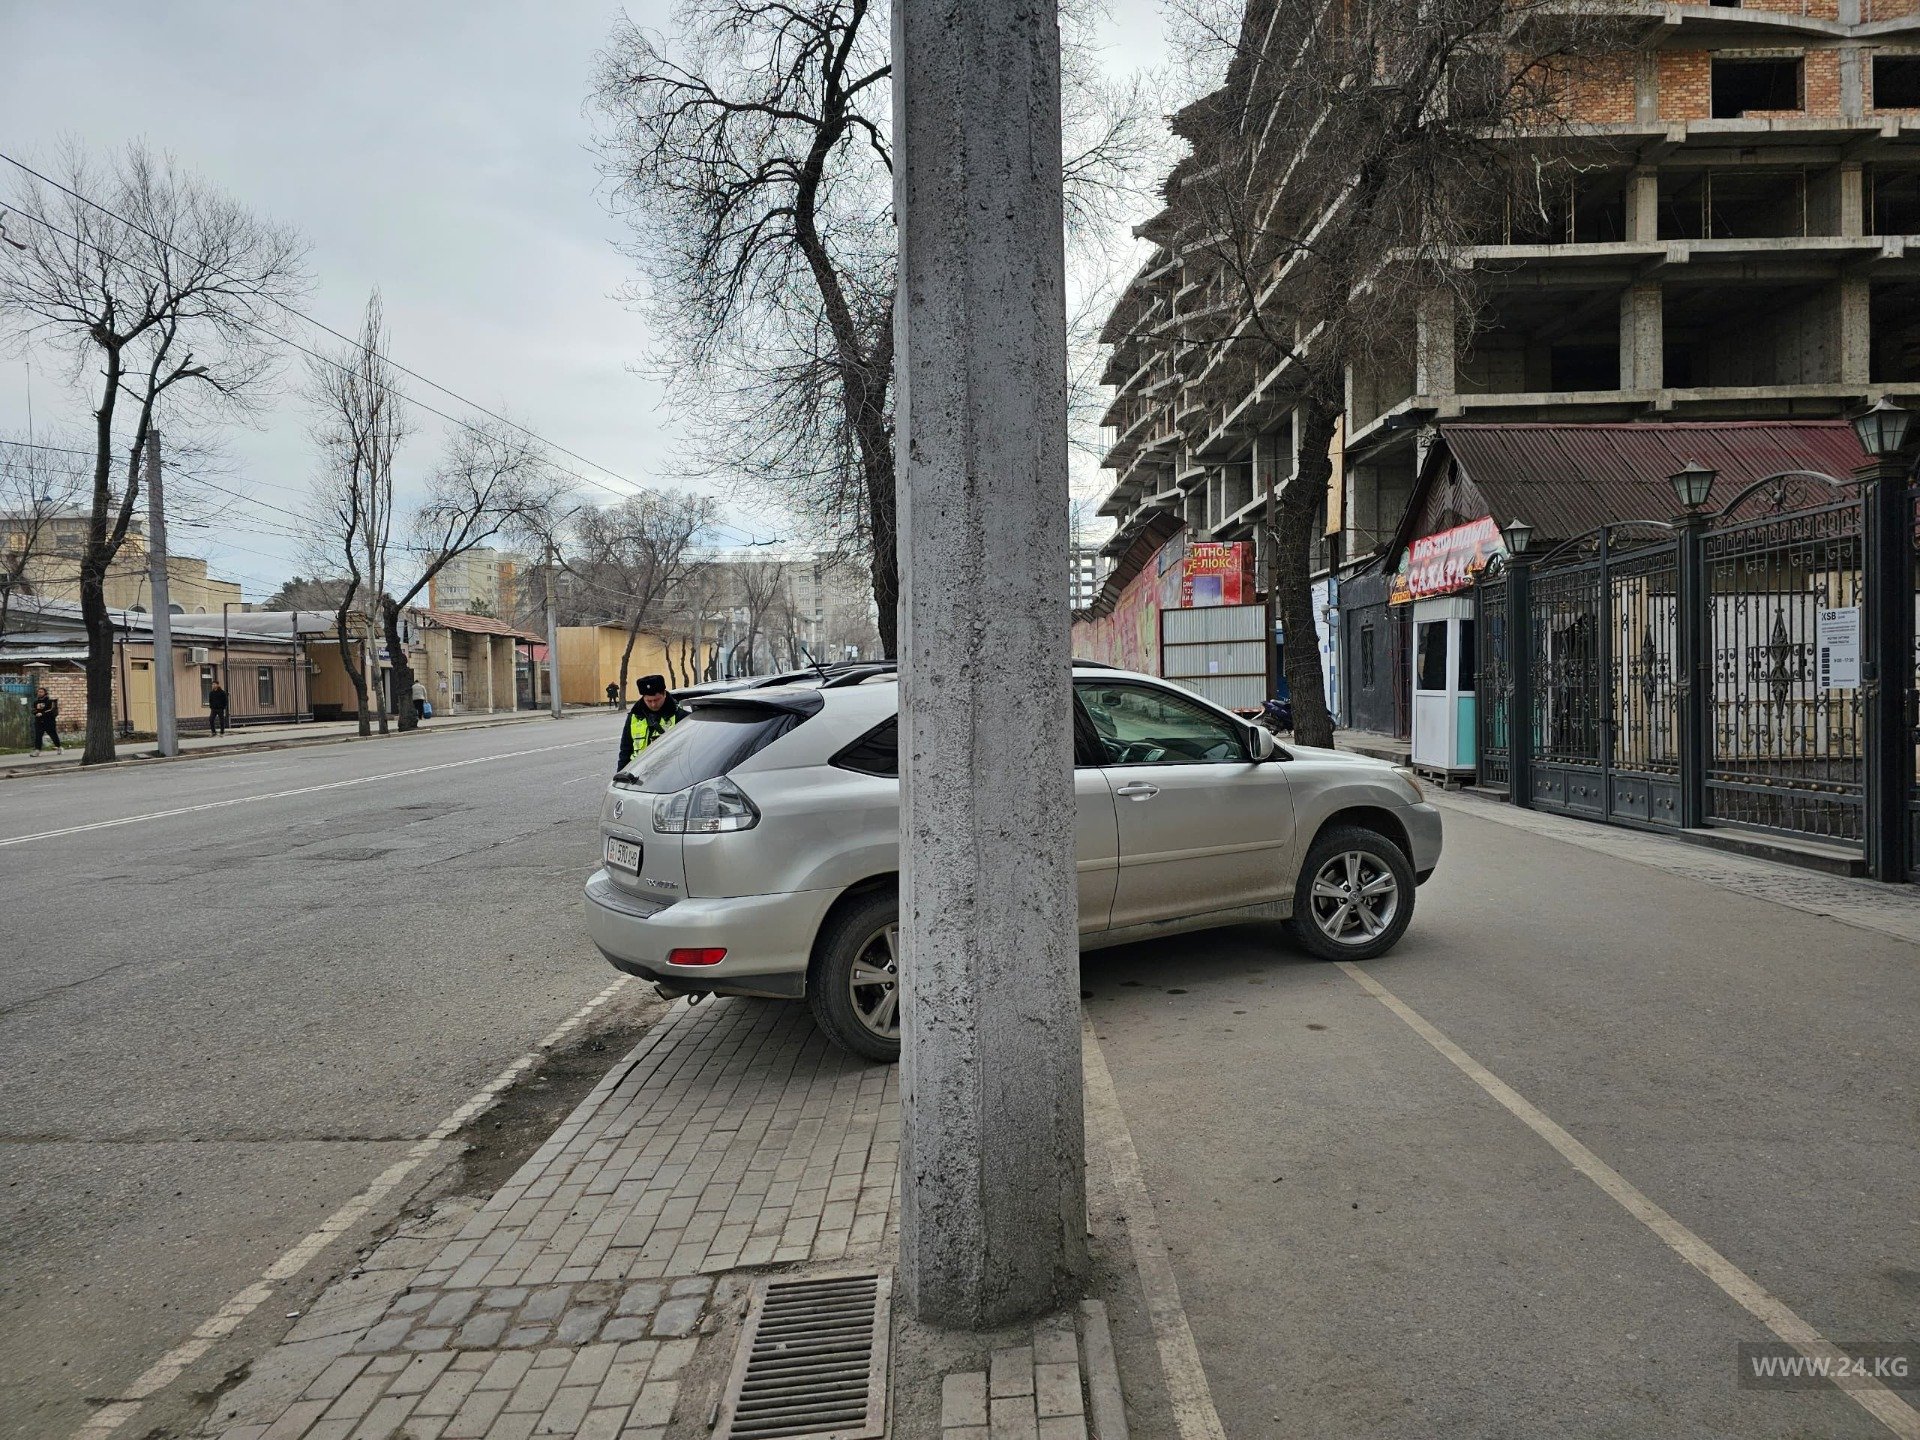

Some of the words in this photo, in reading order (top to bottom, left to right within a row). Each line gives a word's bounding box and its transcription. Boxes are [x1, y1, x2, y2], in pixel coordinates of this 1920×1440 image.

[1191, 547, 1230, 557] ИТНОЕ
[1408, 556, 1467, 594] САХАРА
[1821, 611, 1837, 621] KSB
